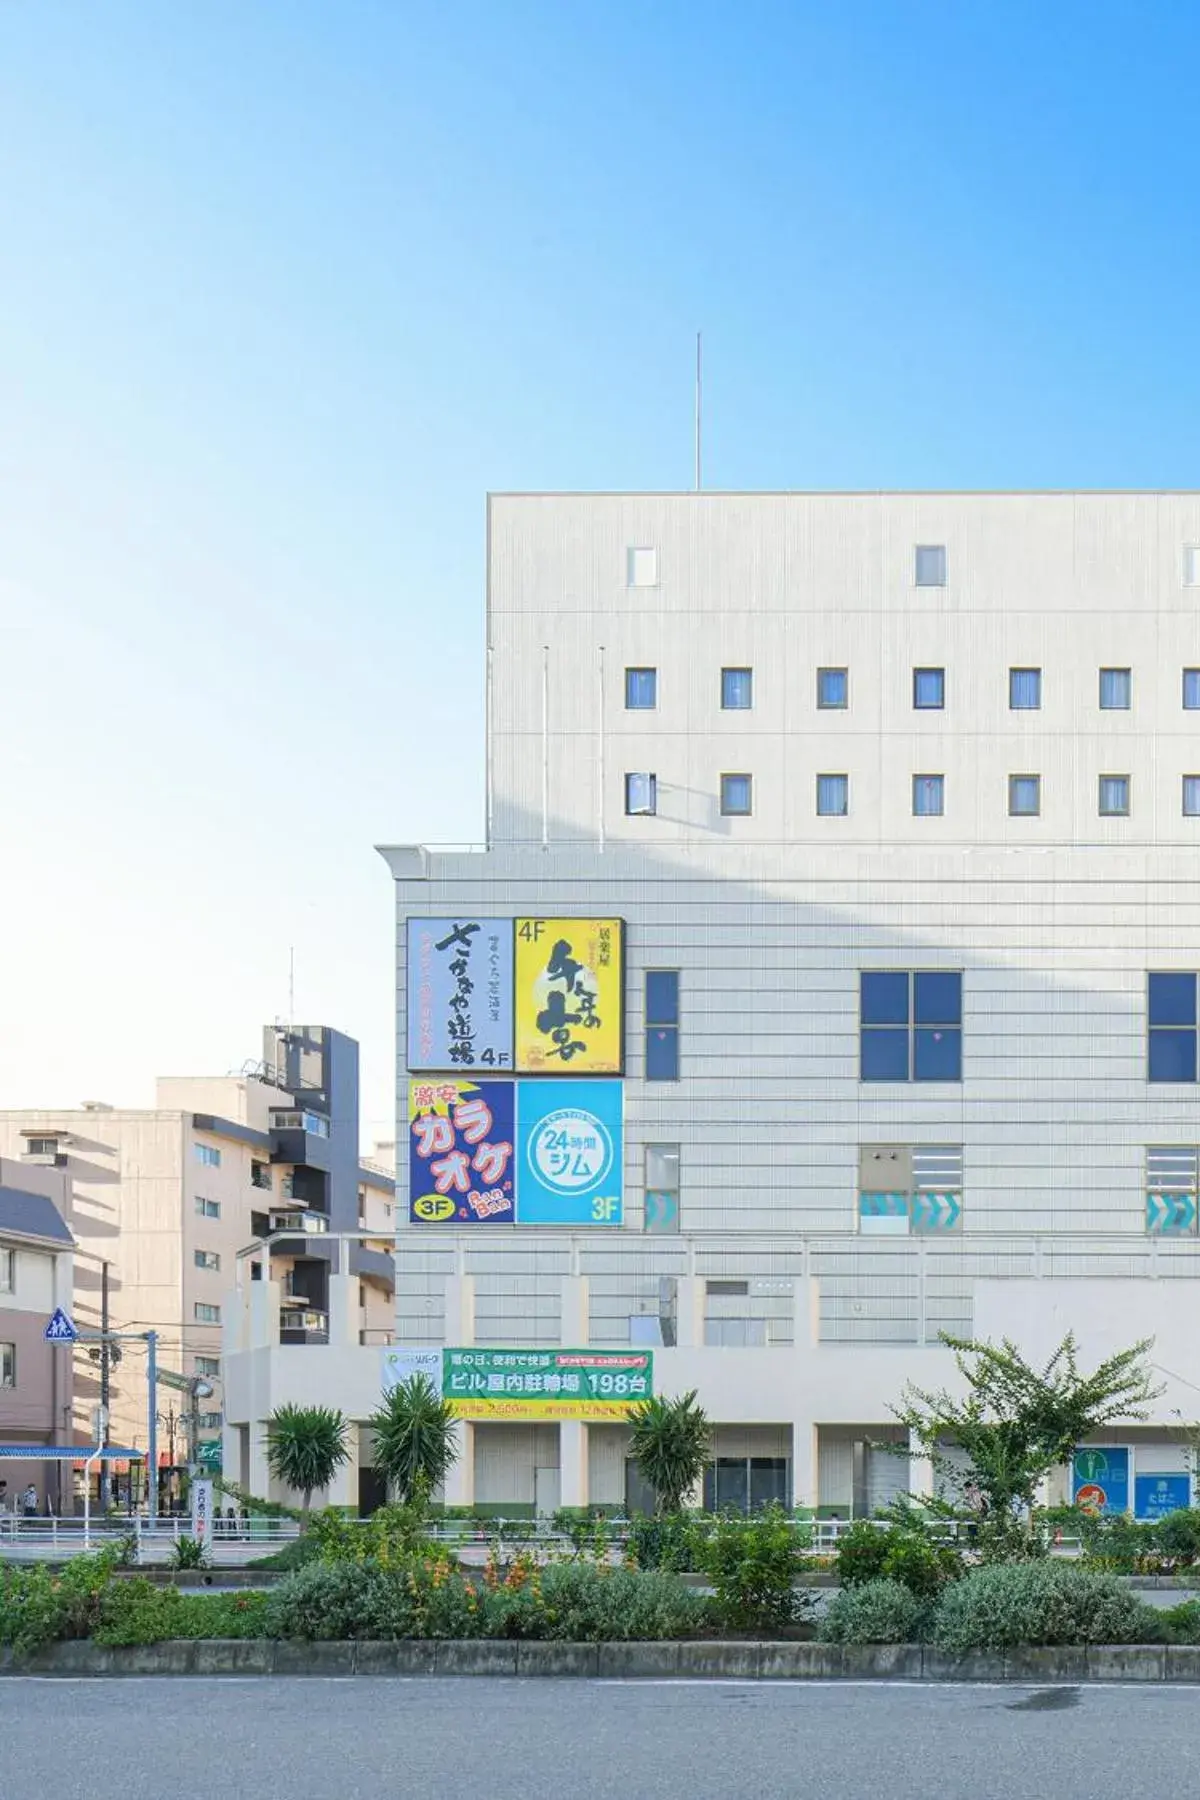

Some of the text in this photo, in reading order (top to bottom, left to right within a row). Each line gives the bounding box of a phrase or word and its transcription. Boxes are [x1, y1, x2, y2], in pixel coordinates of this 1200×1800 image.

[518, 921, 545, 942] 4F
[435, 922, 481, 1065] さかなや道場
[481, 1047, 509, 1066] 4F
[412, 1099, 512, 1194] カラオケ
[544, 1129, 596, 1150] 24時間
[549, 1153, 591, 1176] ジム
[420, 1200, 449, 1216] 3F
[591, 1196, 619, 1220] 3F
[588, 1374, 647, 1393] 198台
